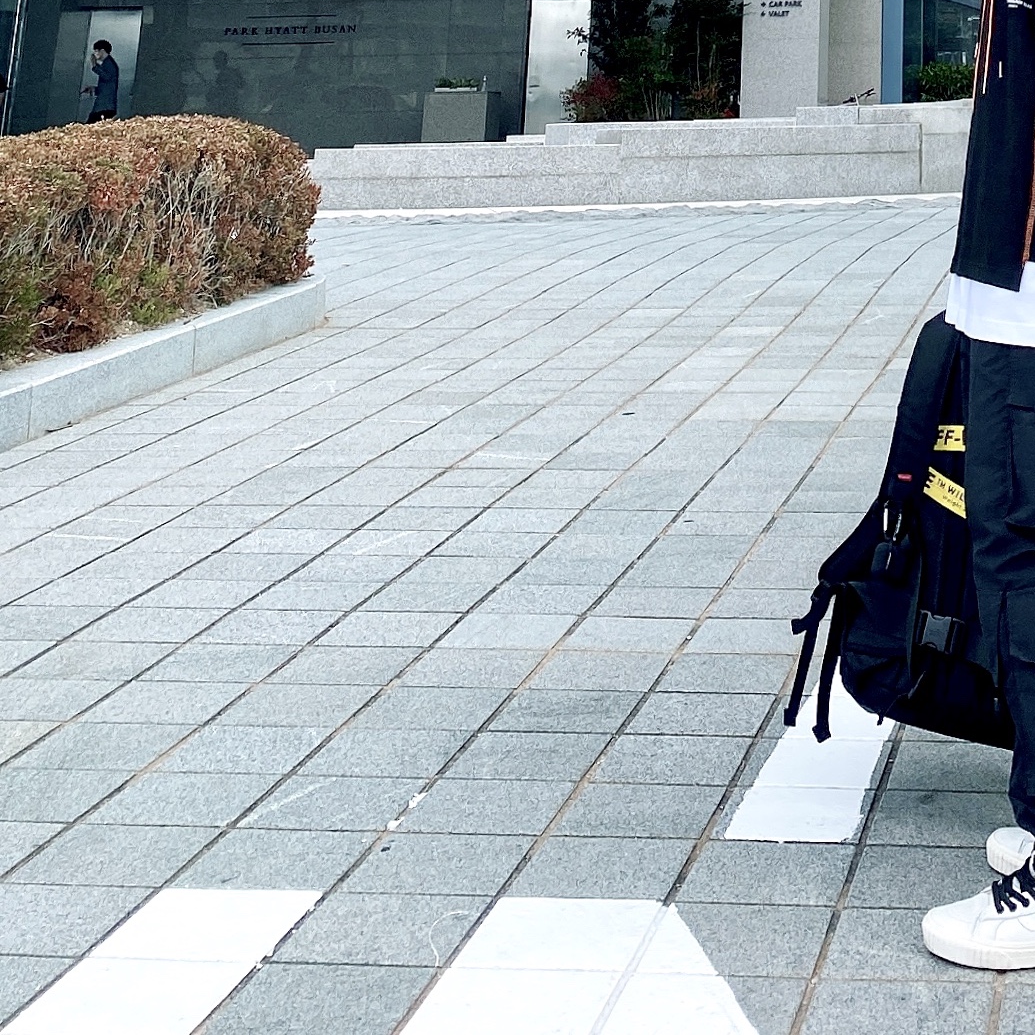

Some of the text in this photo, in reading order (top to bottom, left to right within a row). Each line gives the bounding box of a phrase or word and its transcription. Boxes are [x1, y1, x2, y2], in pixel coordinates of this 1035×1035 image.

[224, 25, 356, 35] PARK HYATT BUSAN
